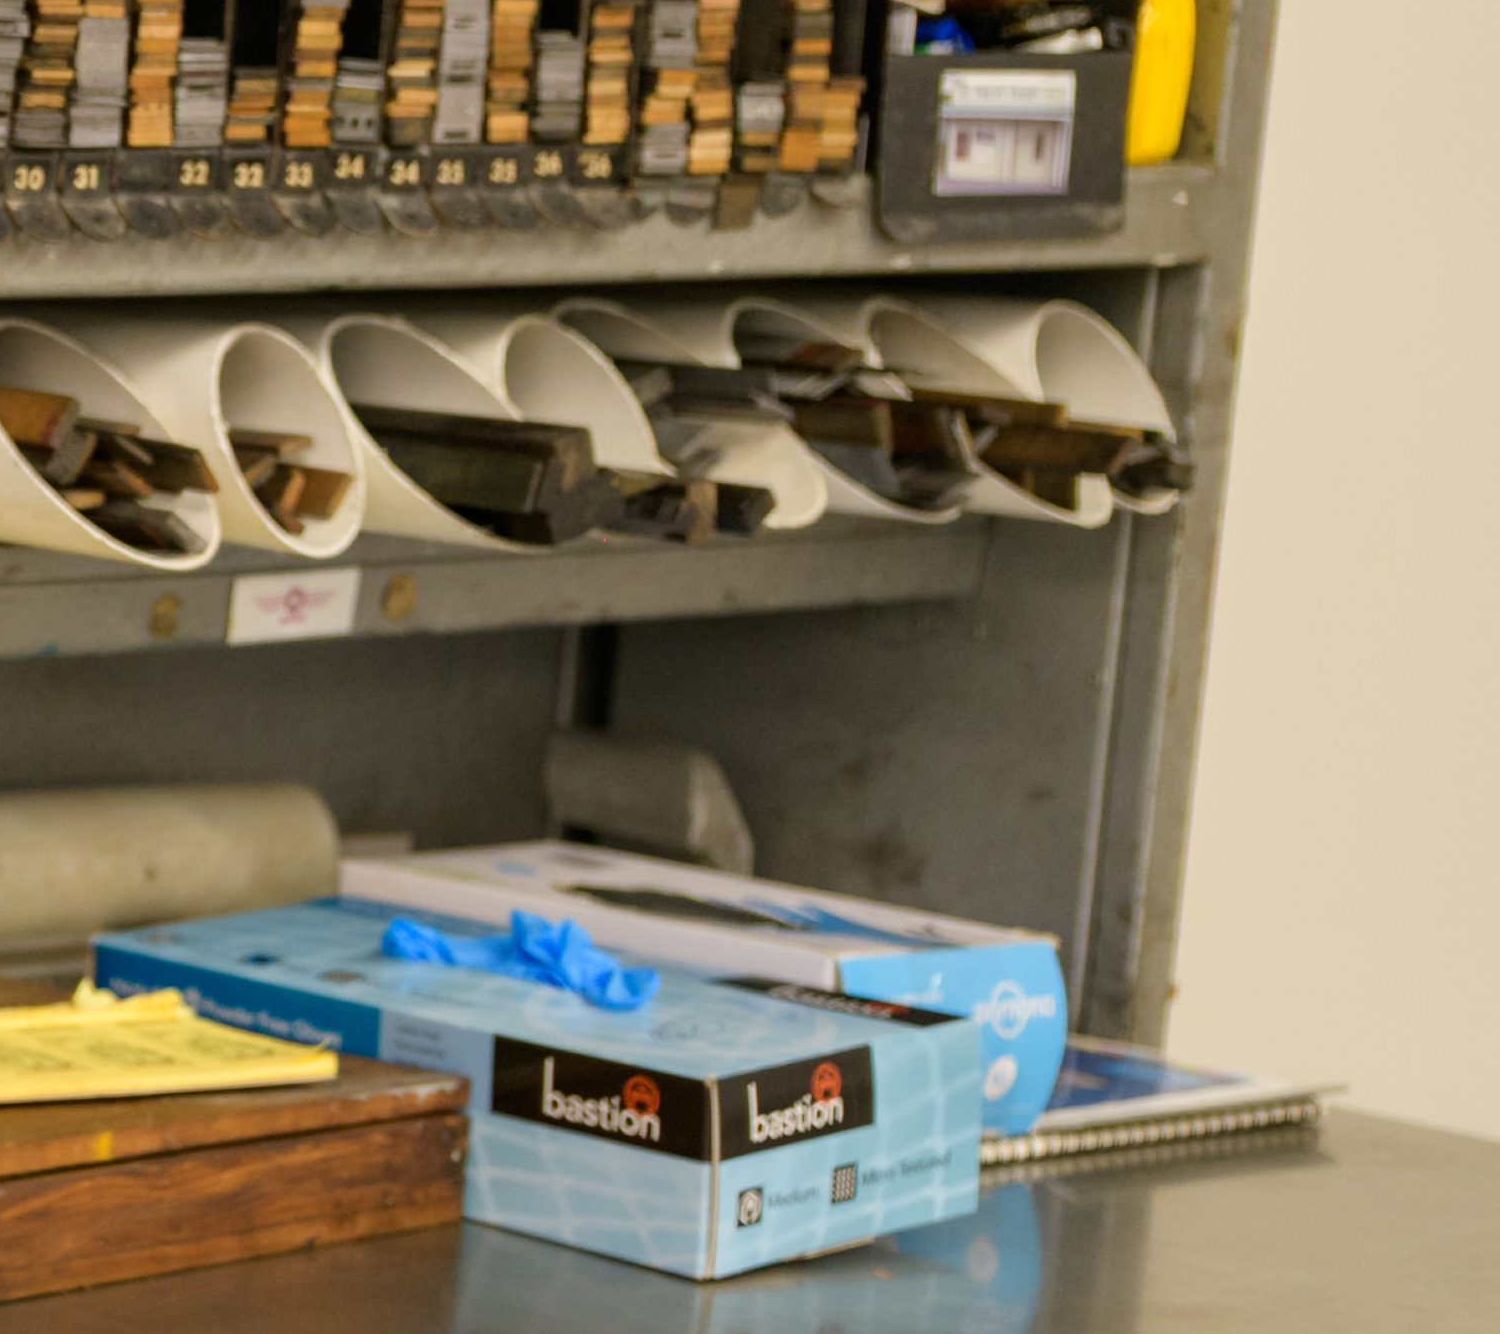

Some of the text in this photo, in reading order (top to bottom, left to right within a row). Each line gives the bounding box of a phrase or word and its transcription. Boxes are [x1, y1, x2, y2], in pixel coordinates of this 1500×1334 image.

[13, 166, 46, 192] 30
[73, 165, 100, 191] 31
[542, 1056, 661, 1142] bastion
[747, 1081, 844, 1144] bastion
